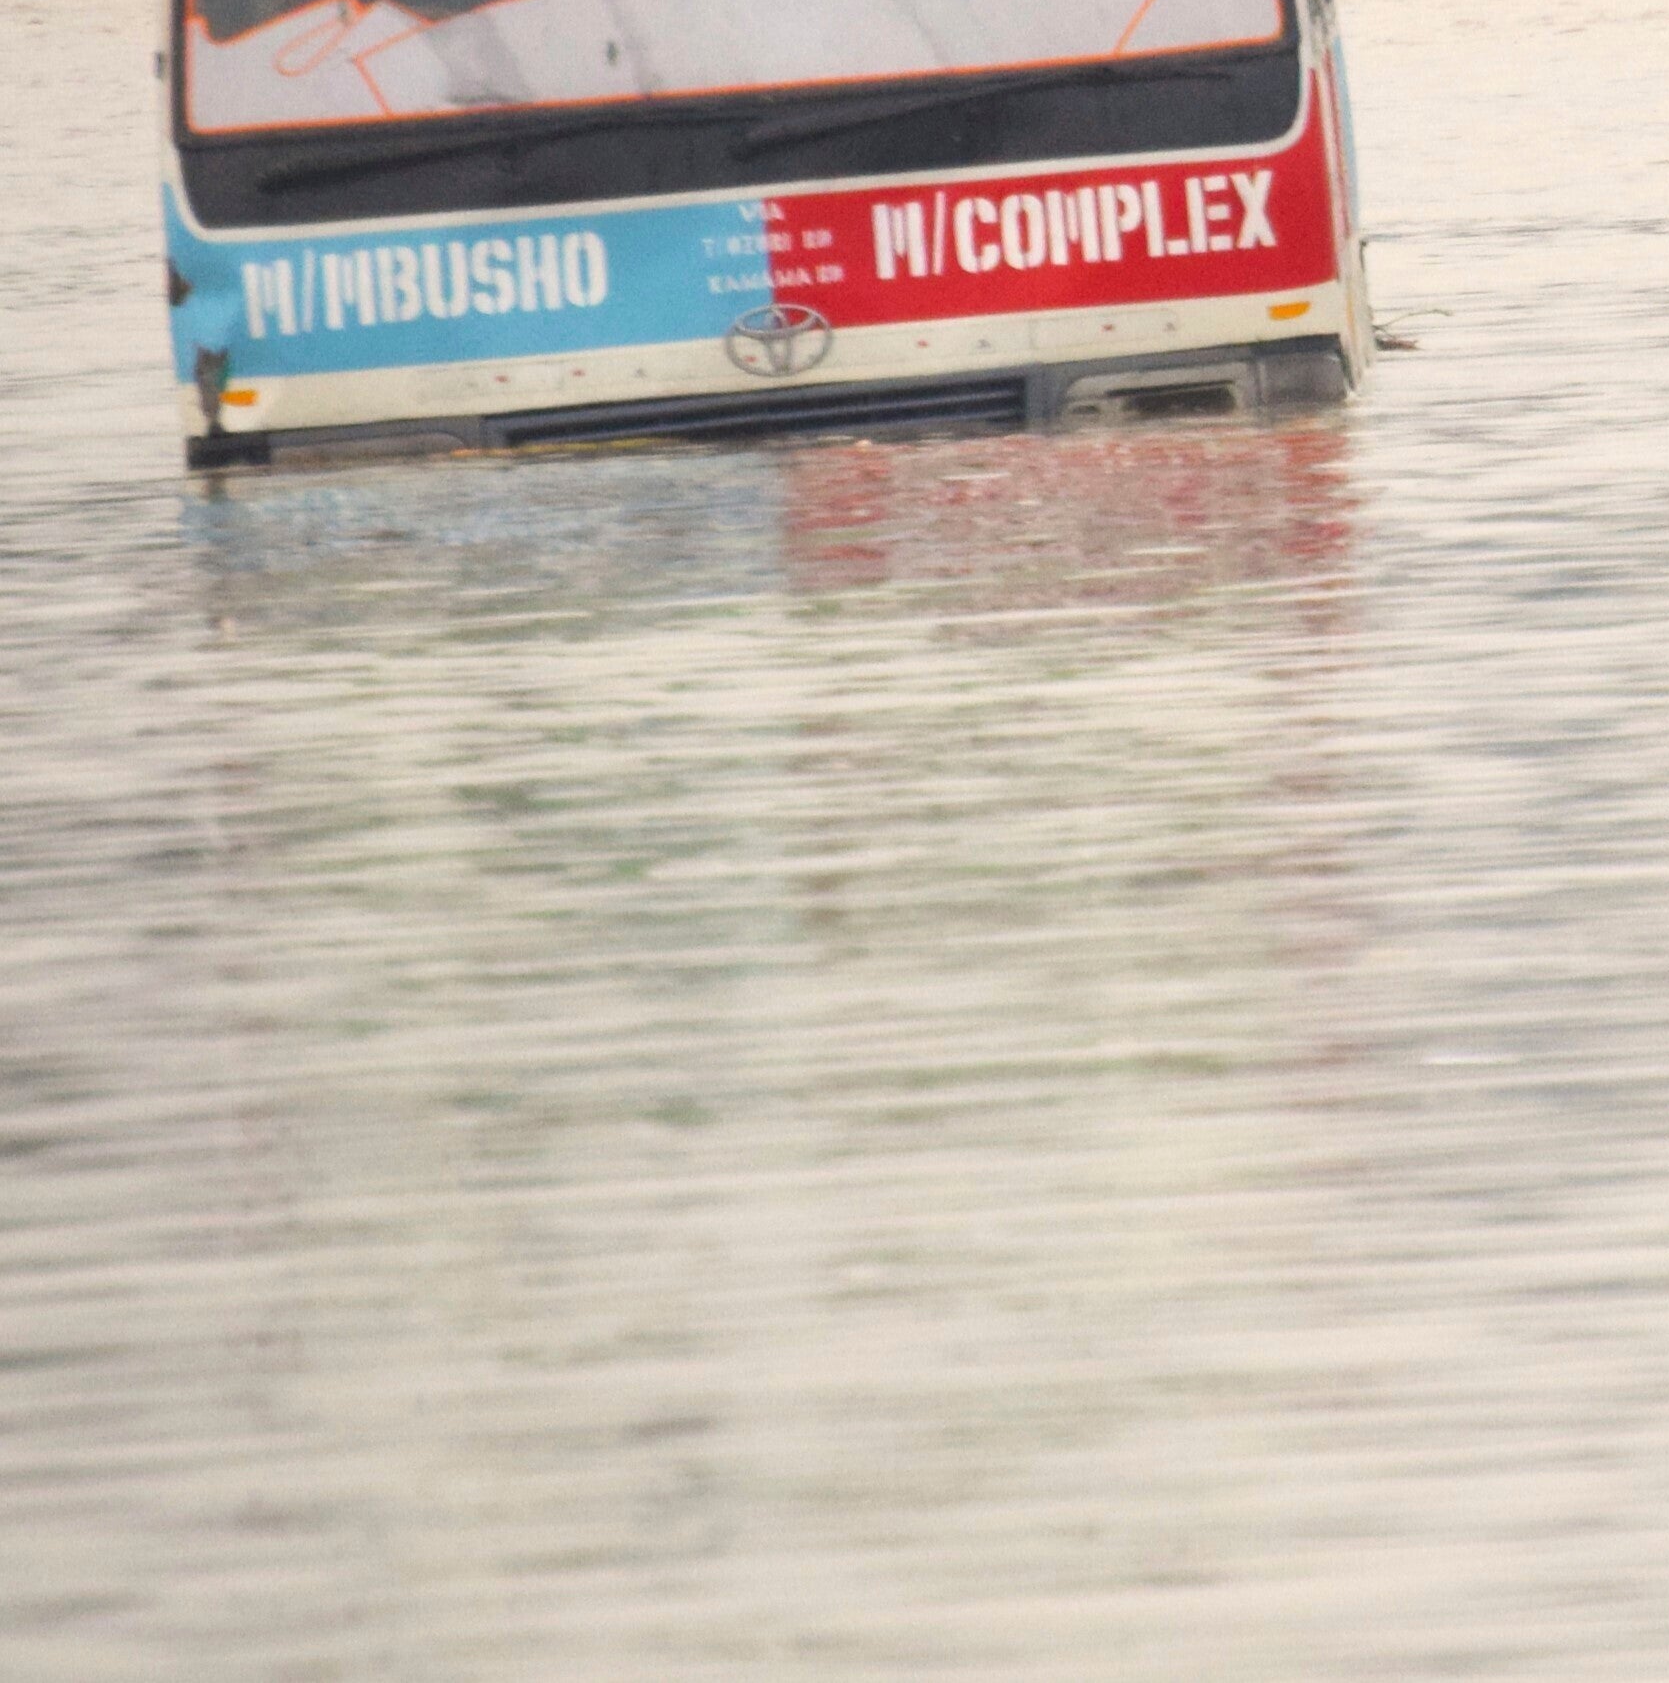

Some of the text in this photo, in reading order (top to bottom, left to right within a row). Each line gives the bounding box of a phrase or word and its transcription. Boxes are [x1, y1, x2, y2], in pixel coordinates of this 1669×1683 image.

[738, 201, 785, 222] VIA
[870, 168, 1278, 281] M/COMPLEX
[242, 231, 609, 339] M/MBUSHO
